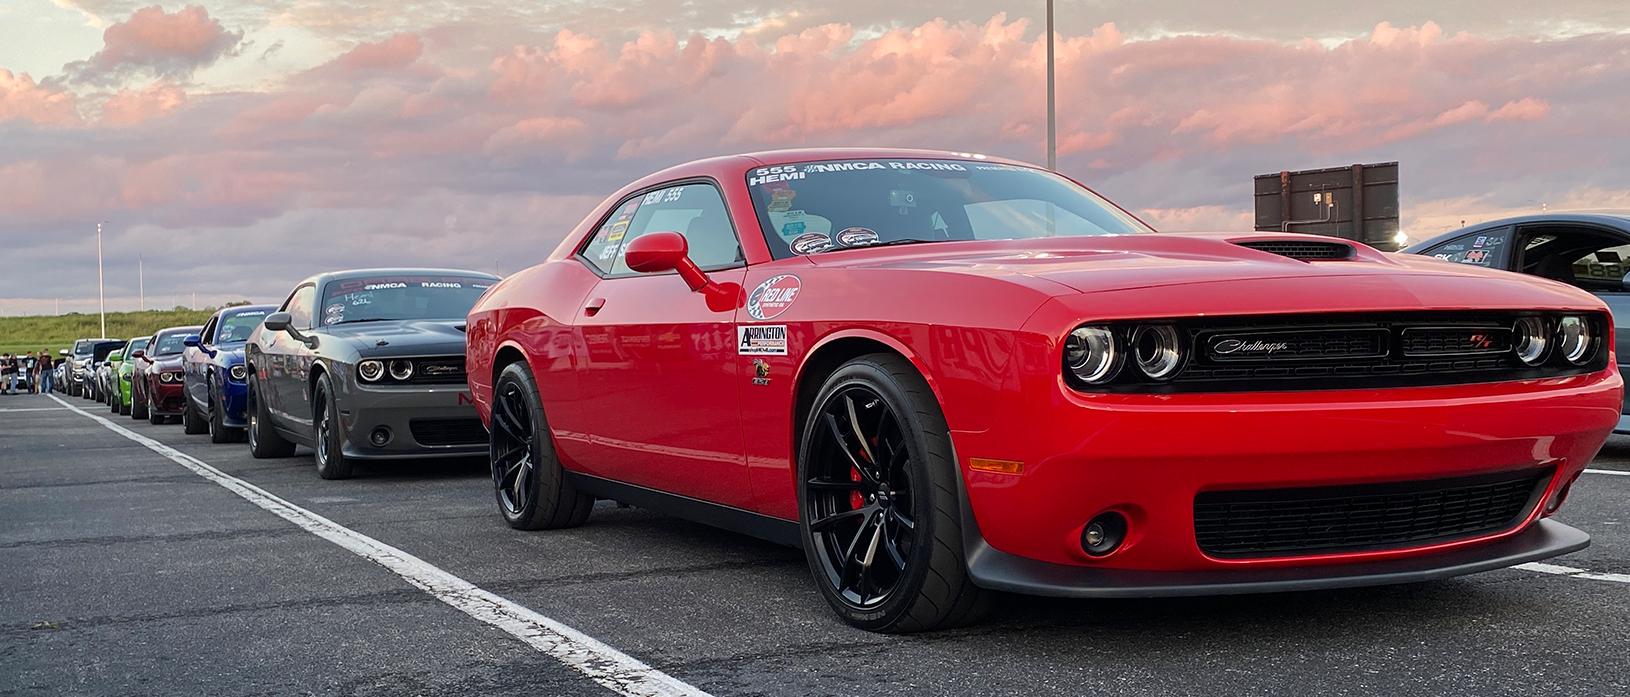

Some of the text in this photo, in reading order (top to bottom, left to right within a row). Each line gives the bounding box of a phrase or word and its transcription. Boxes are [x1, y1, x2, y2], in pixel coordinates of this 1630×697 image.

[756, 165, 797, 176] 555
[815, 162, 886, 173] NMCA
[889, 162, 967, 171] RACING
[750, 171, 806, 186] HEMI
[641, 187, 684, 206] HEMI 555
[599, 243, 620, 260] JEFF
[371, 282, 408, 290] NMCA
[760, 287, 799, 302] RED LINE
[741, 327, 786, 346] ARRINGTON
[1470, 334, 1493, 348] R/T
[1213, 339, 1288, 354] Challenger
